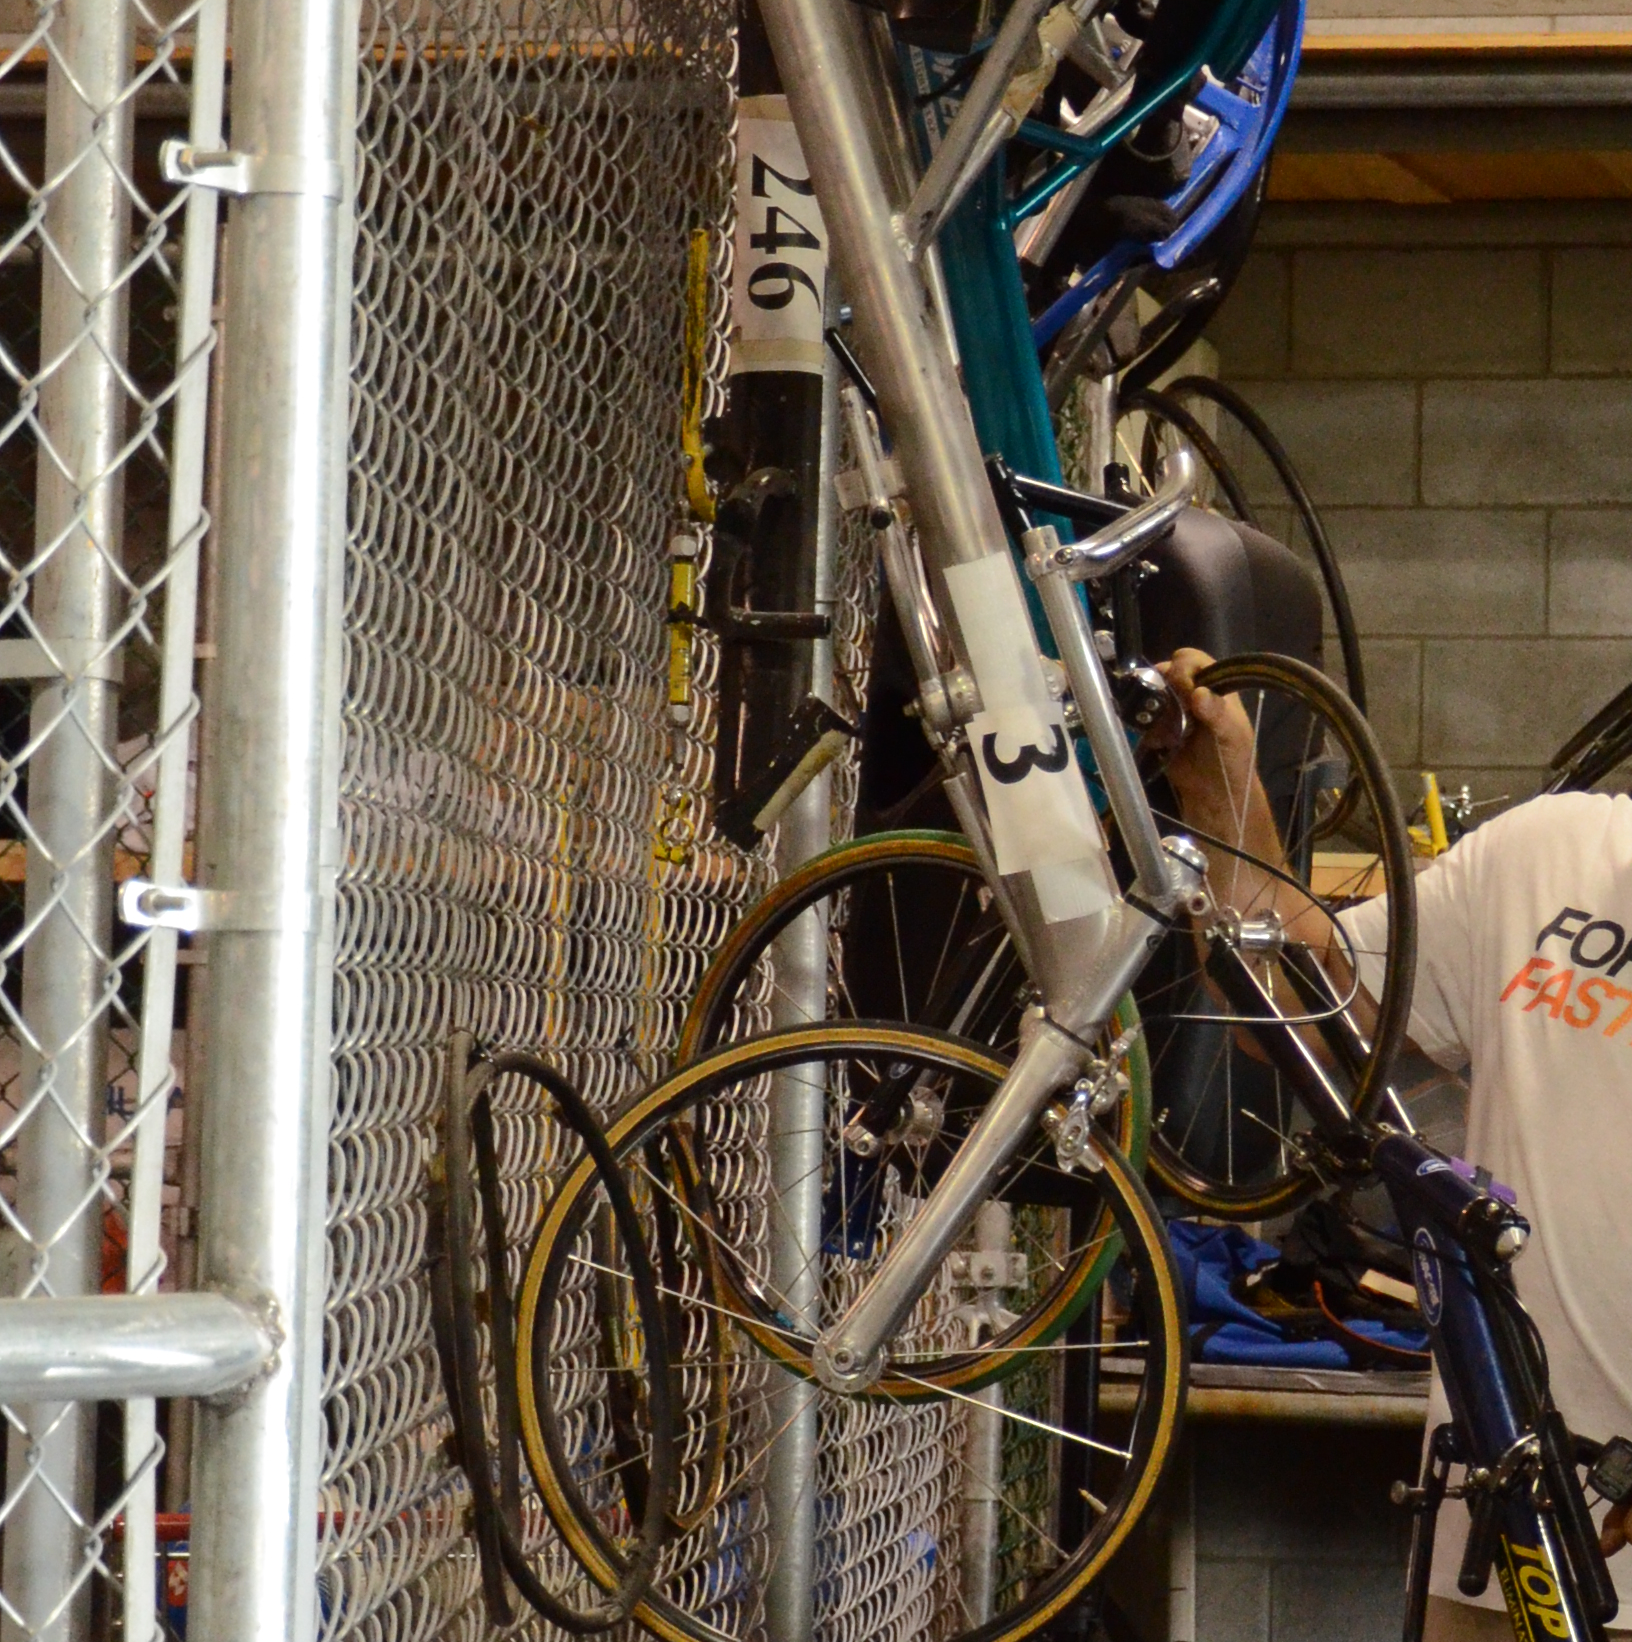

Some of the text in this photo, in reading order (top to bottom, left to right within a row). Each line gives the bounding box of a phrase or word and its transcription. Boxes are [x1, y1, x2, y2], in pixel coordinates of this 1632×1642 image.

[748, 153, 822, 314] 246
[982, 724, 1069, 785] 3
[1511, 1543, 1570, 1639] TOP
